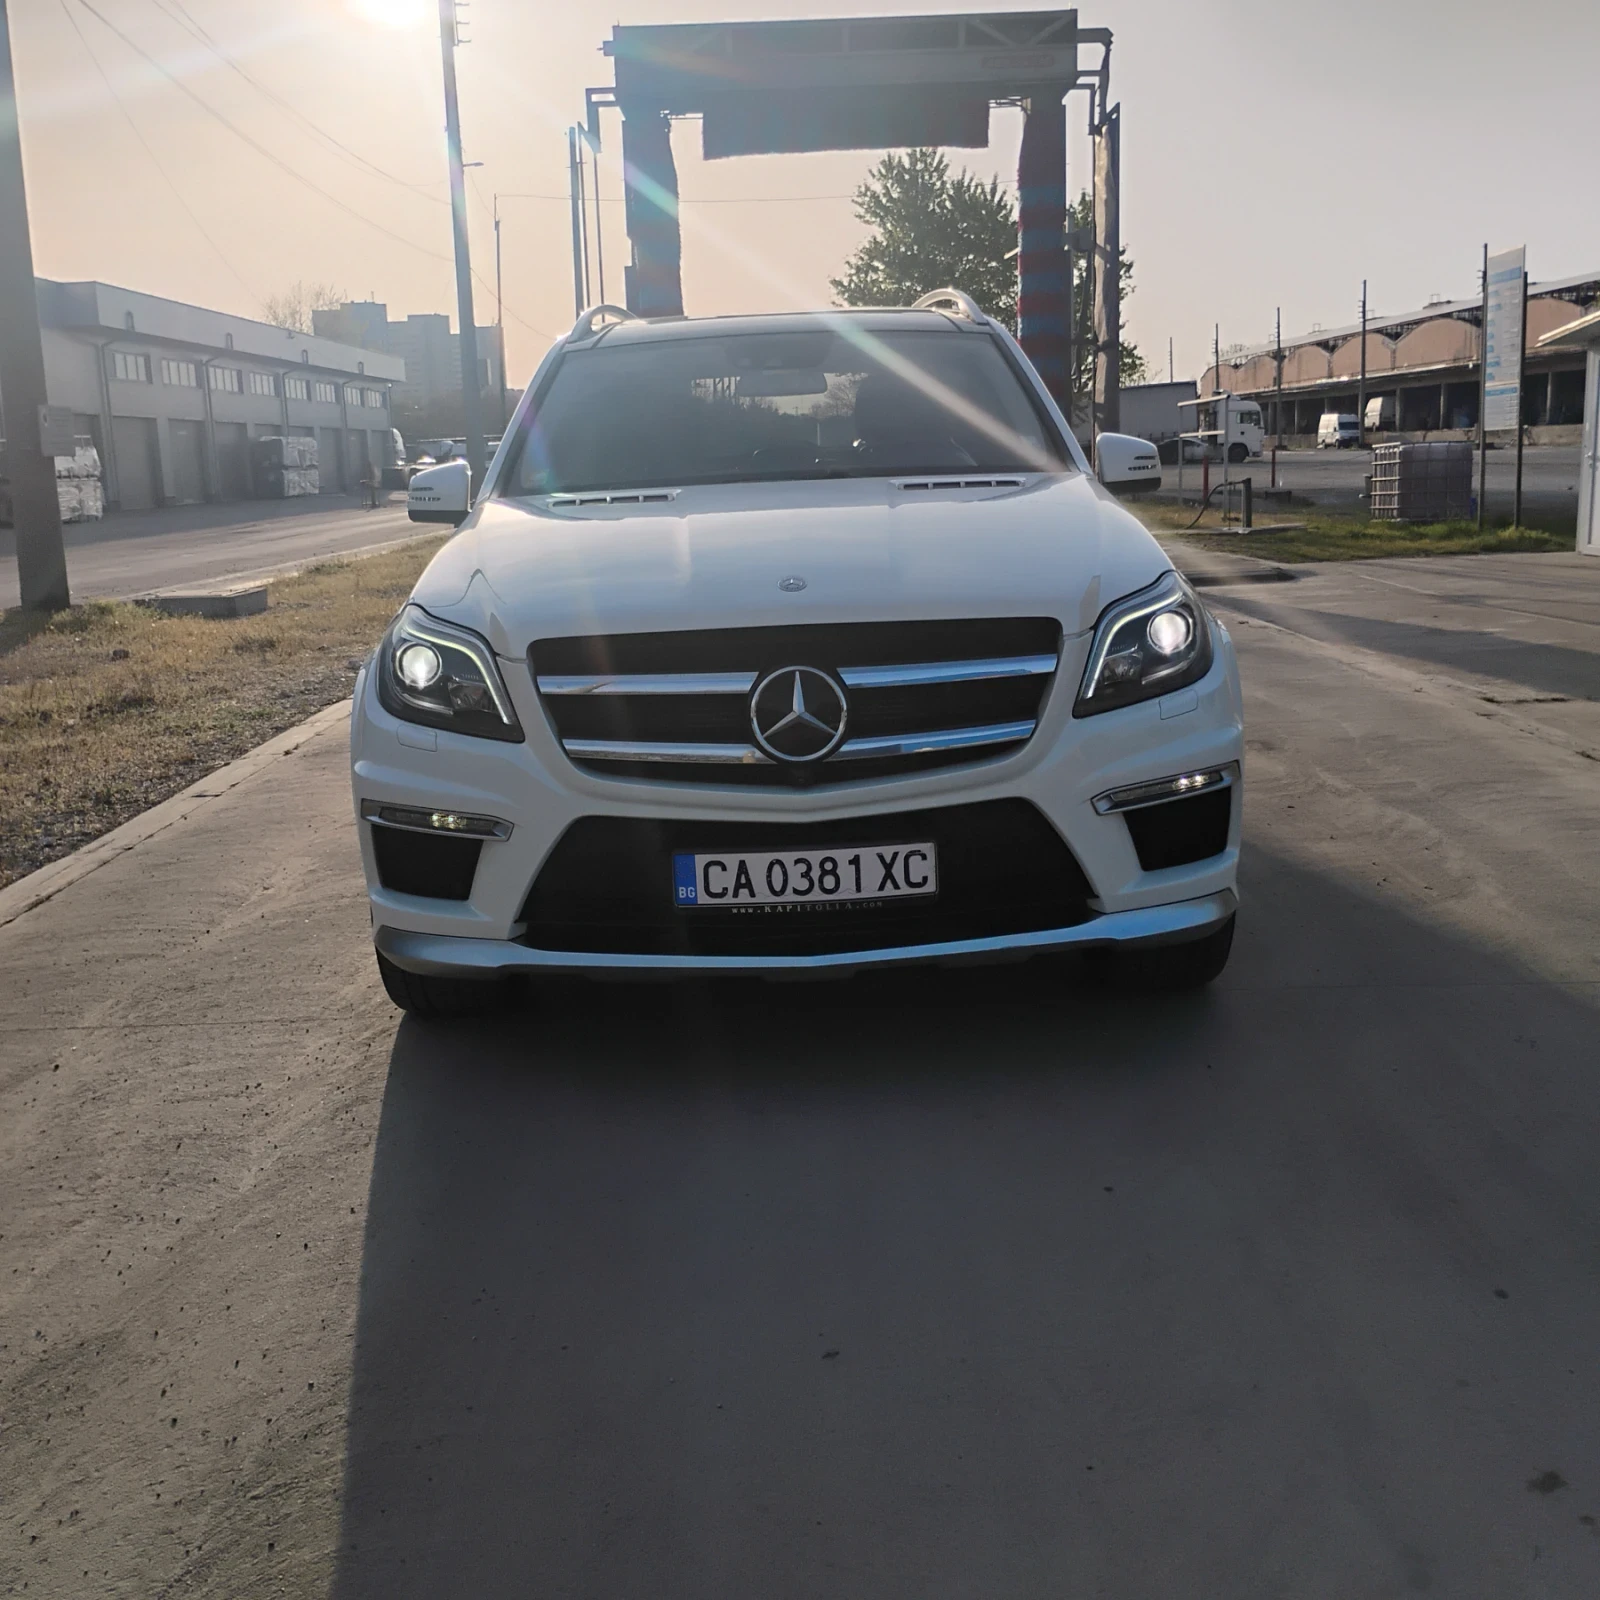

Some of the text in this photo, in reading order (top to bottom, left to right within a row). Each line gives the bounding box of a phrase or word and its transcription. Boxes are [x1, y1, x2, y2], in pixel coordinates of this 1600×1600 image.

[703, 850, 929, 898] CA 0381 XC
[678, 887, 696, 898] BG
